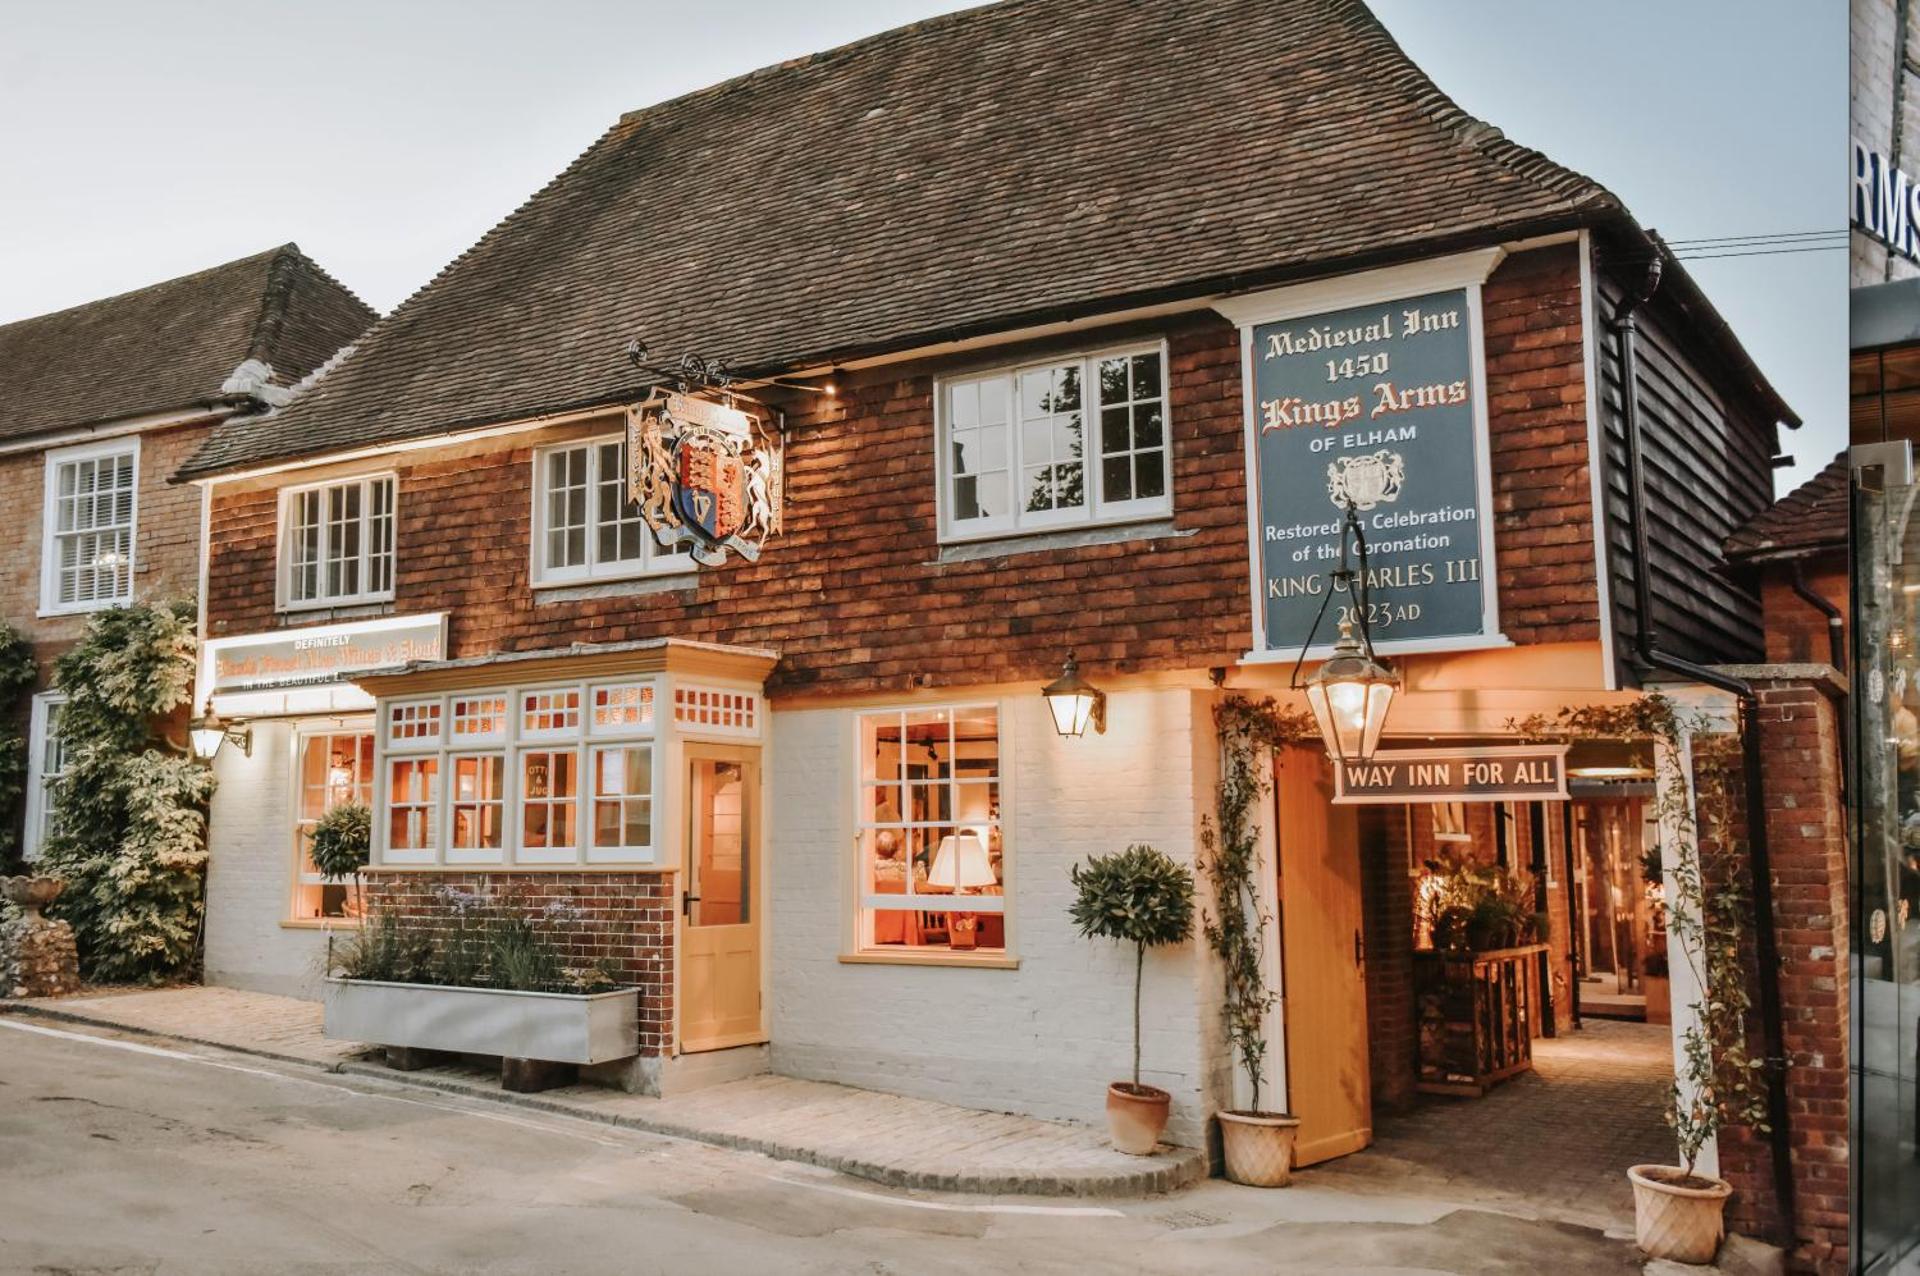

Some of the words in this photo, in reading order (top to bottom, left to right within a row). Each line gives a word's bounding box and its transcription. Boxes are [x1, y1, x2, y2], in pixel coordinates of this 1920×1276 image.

[1265, 314, 1393, 360] Medieval
[1402, 308, 1459, 339] Inn
[1326, 352, 1390, 383] 1450
[1261, 396, 1361, 437] Kings
[1371, 380, 1467, 420] Arms
[1310, 436, 1337, 453] OF
[1343, 426, 1417, 449] ELHAM
[1266, 518, 1340, 542] Restored
[1372, 507, 1476, 530] Celebration
[1292, 544, 1310, 562] of
[1352, 534, 1450, 556] Coronation
[1268, 573, 1322, 599] KING
[1445, 558, 1480, 584] III
[295, 636, 350, 649] DEFINITELY
[280, 674, 332, 687] BEAUTIFUL
[1347, 766, 1396, 787] WAY
[1408, 764, 1450, 786] INN
[1463, 763, 1504, 785] FOR
[1514, 761, 1555, 784] ALL
